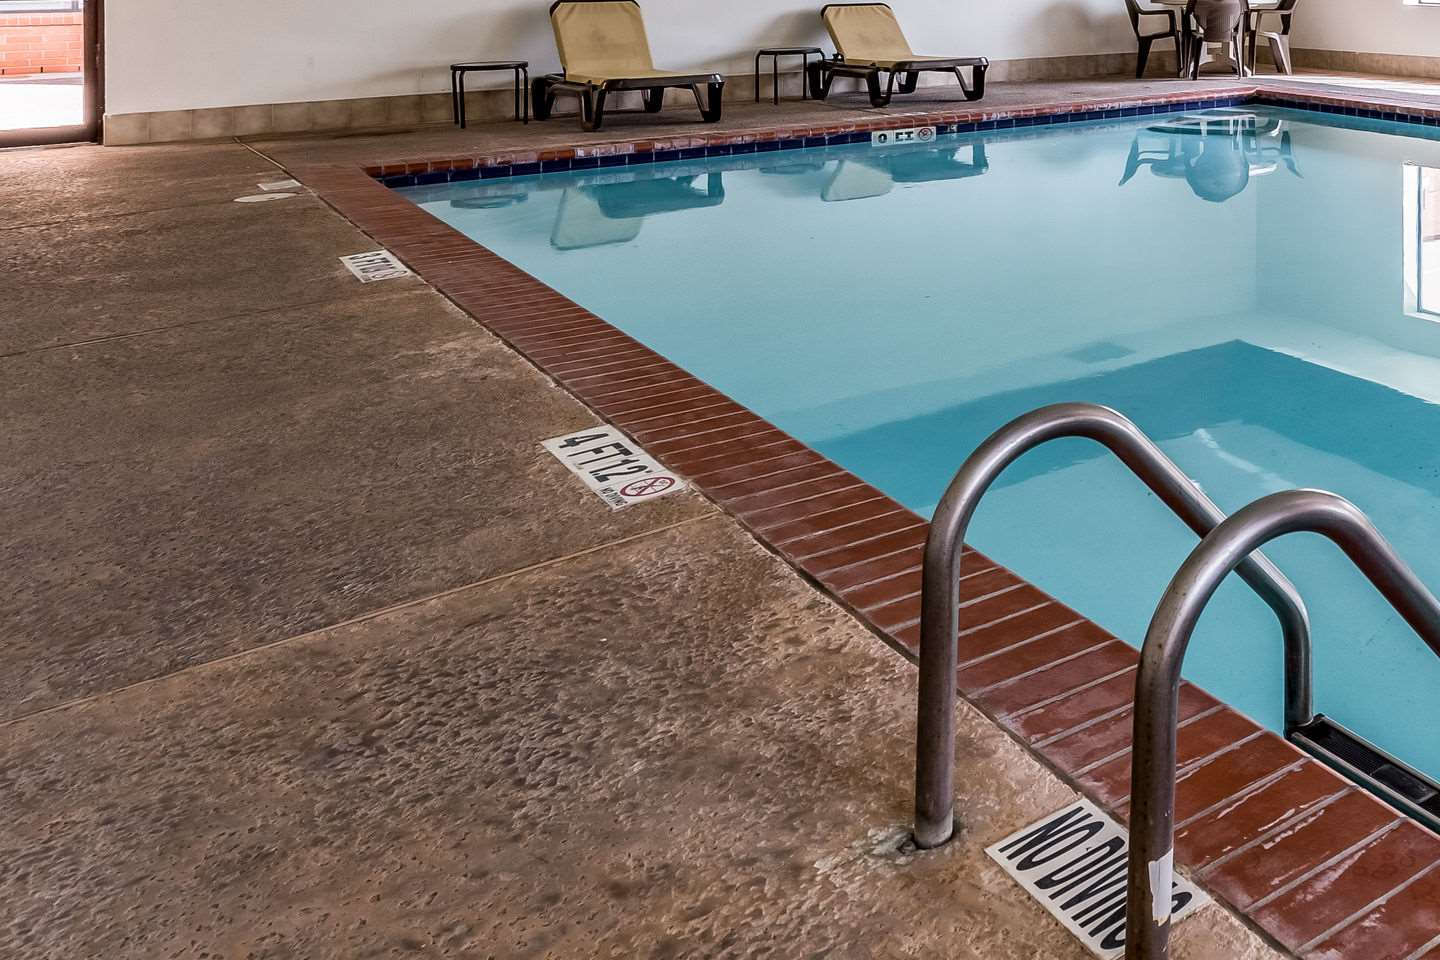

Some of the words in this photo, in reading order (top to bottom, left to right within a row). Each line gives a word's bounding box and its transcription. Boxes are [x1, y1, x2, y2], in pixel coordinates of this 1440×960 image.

[559, 433, 609, 448] 4
[567, 442, 633, 465] FT
[998, 806, 1105, 871] NO
